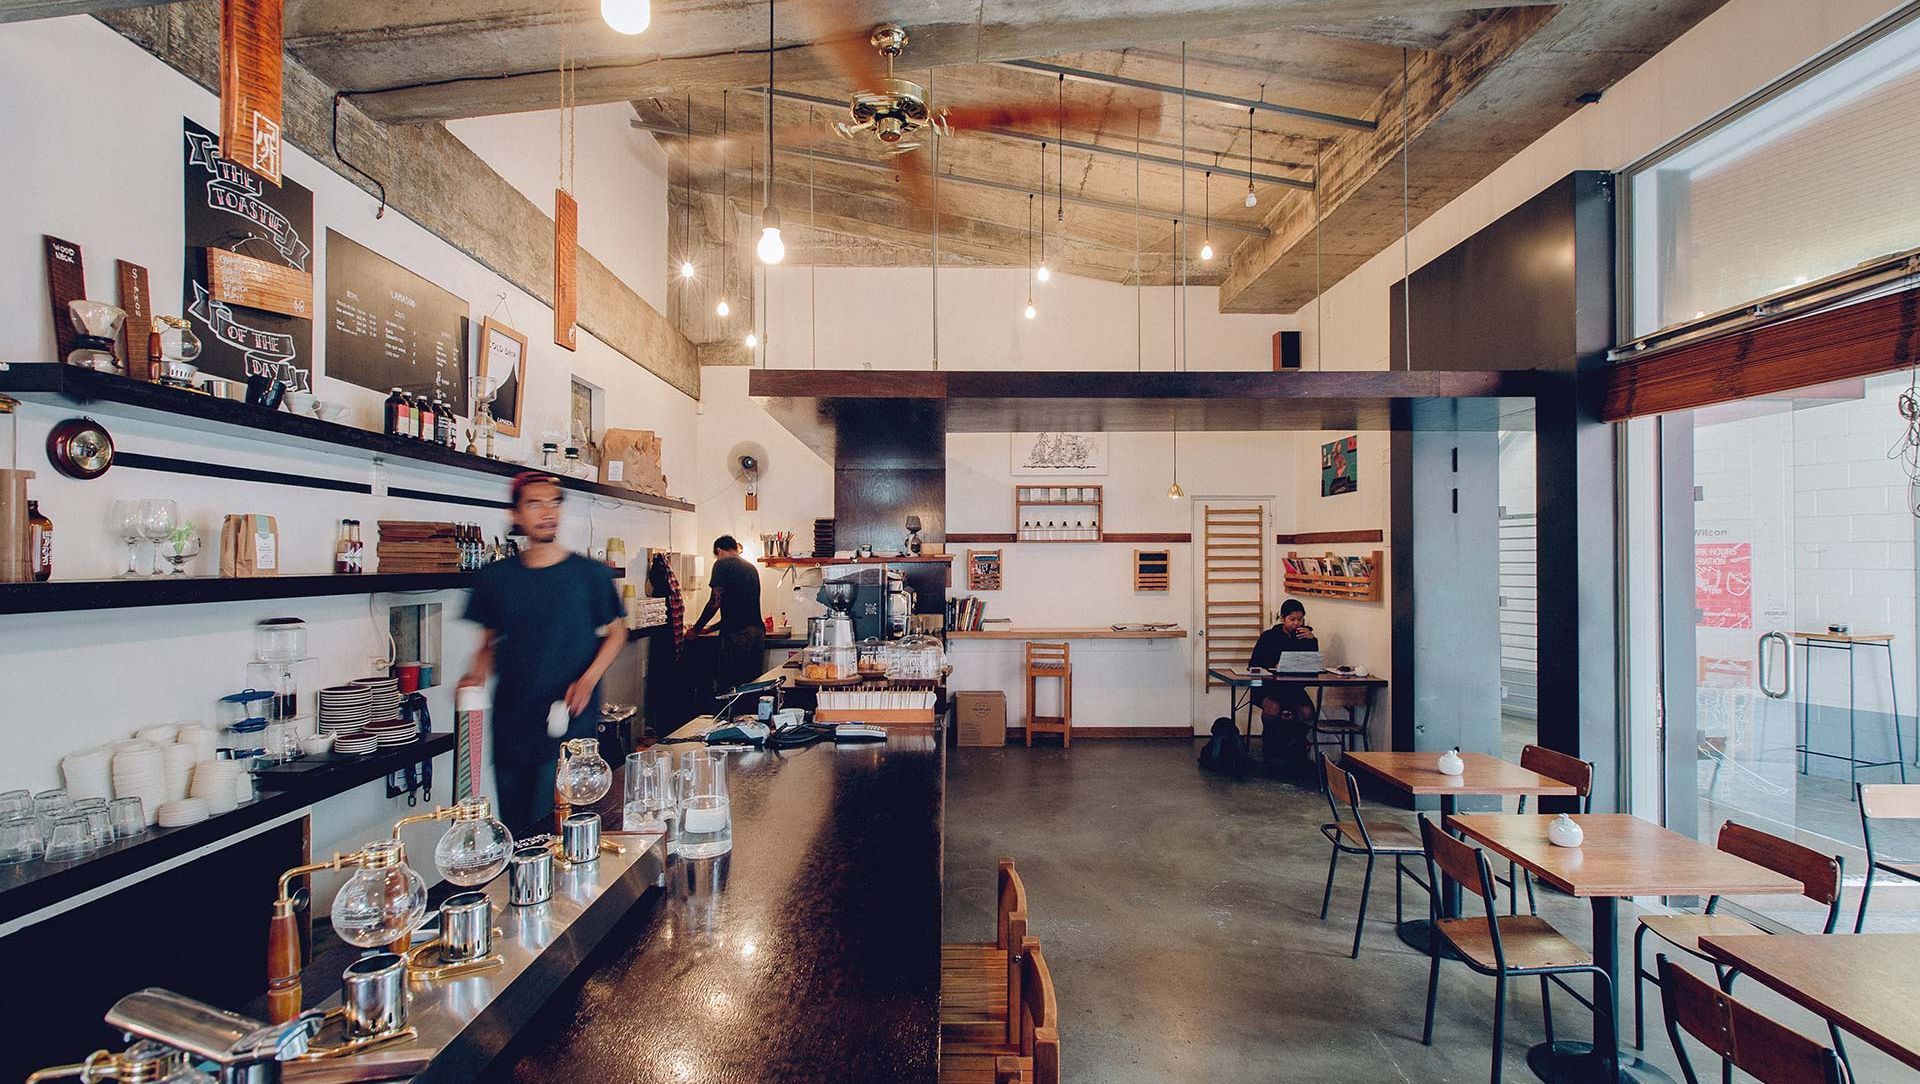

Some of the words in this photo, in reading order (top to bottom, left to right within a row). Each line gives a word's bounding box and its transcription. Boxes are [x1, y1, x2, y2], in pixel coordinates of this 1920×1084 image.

[217, 160, 257, 191] THE
[212, 187, 287, 236] TOASTIE
[52, 242, 75, 256] WOOD
[227, 325, 248, 343] OF
[252, 332, 280, 353] THE
[252, 359, 280, 380] DAY
